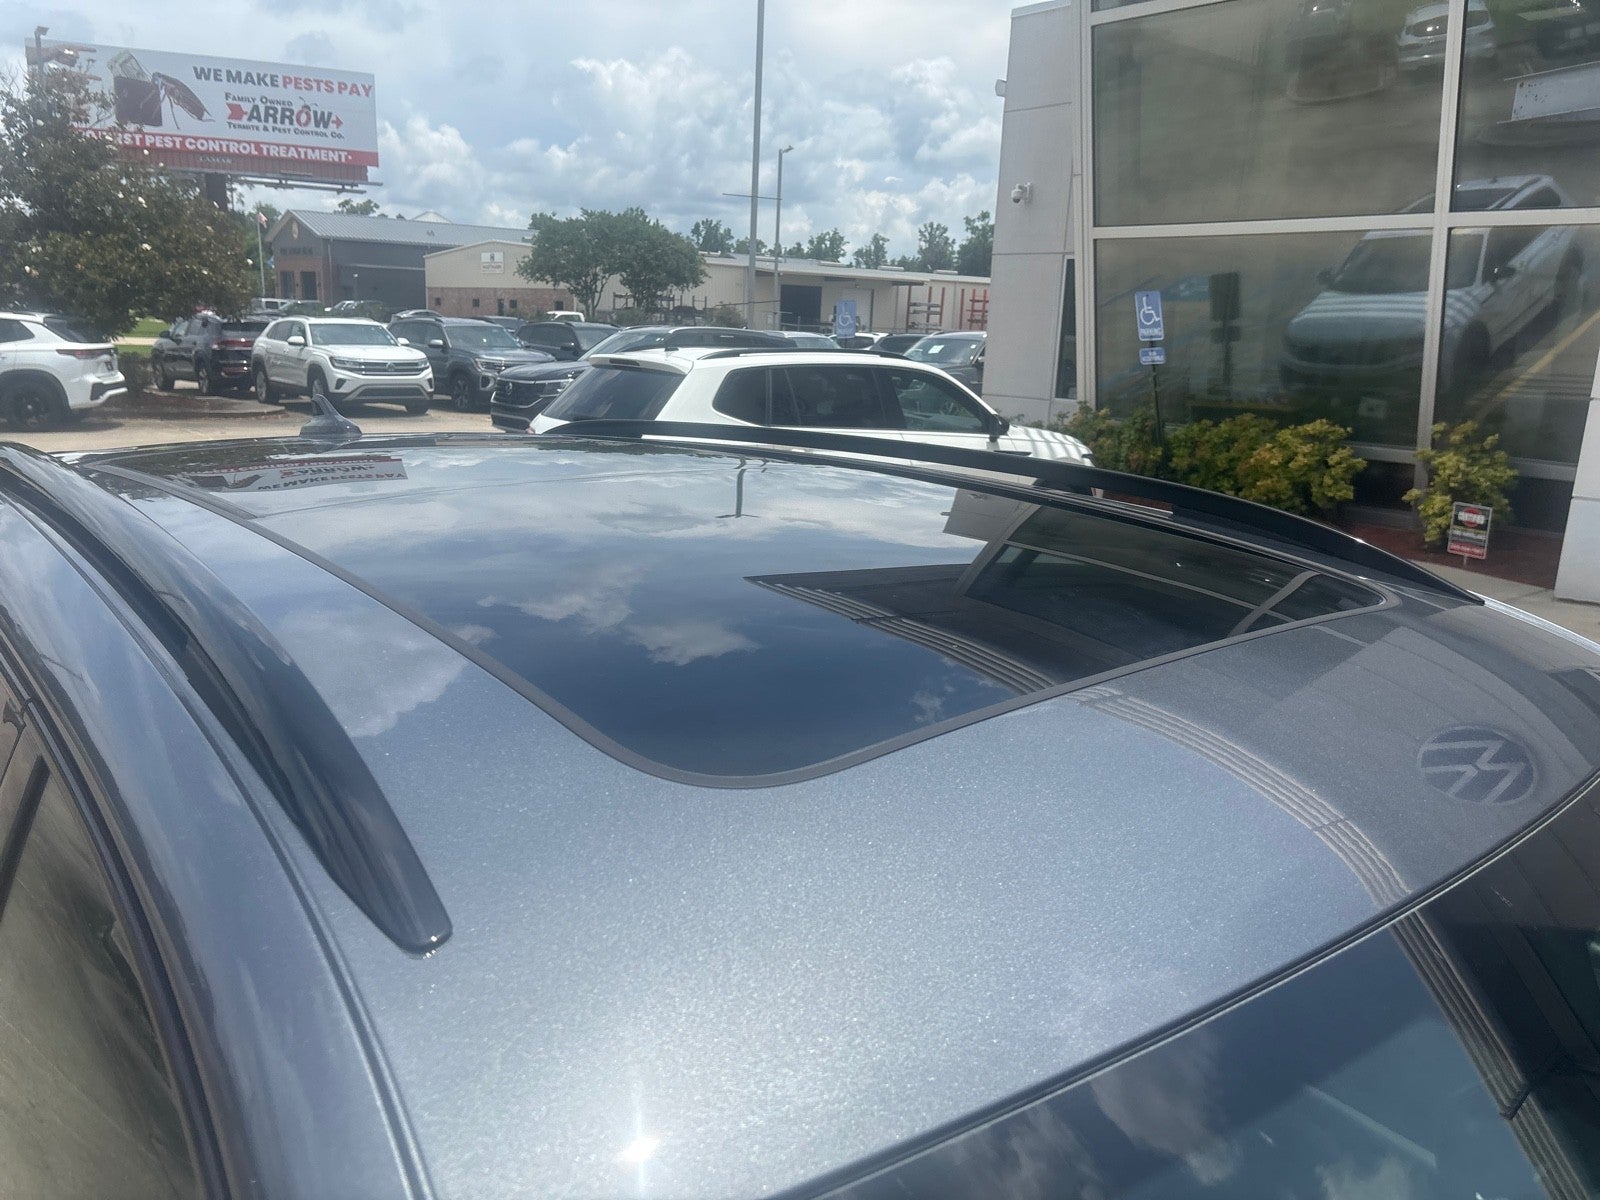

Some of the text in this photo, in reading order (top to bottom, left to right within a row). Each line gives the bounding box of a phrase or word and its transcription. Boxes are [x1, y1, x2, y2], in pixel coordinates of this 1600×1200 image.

[192, 66, 372, 97] WE MAKE PESTS PAY
[260, 95, 293, 107] OWNED
[247, 104, 332, 130] ARROW
[226, 121, 260, 132] TERMITE
[272, 126, 291, 134] PEST
[293, 128, 328, 138] CONTROL
[144, 133, 182, 150] PEST
[185, 138, 258, 156] CONTROL
